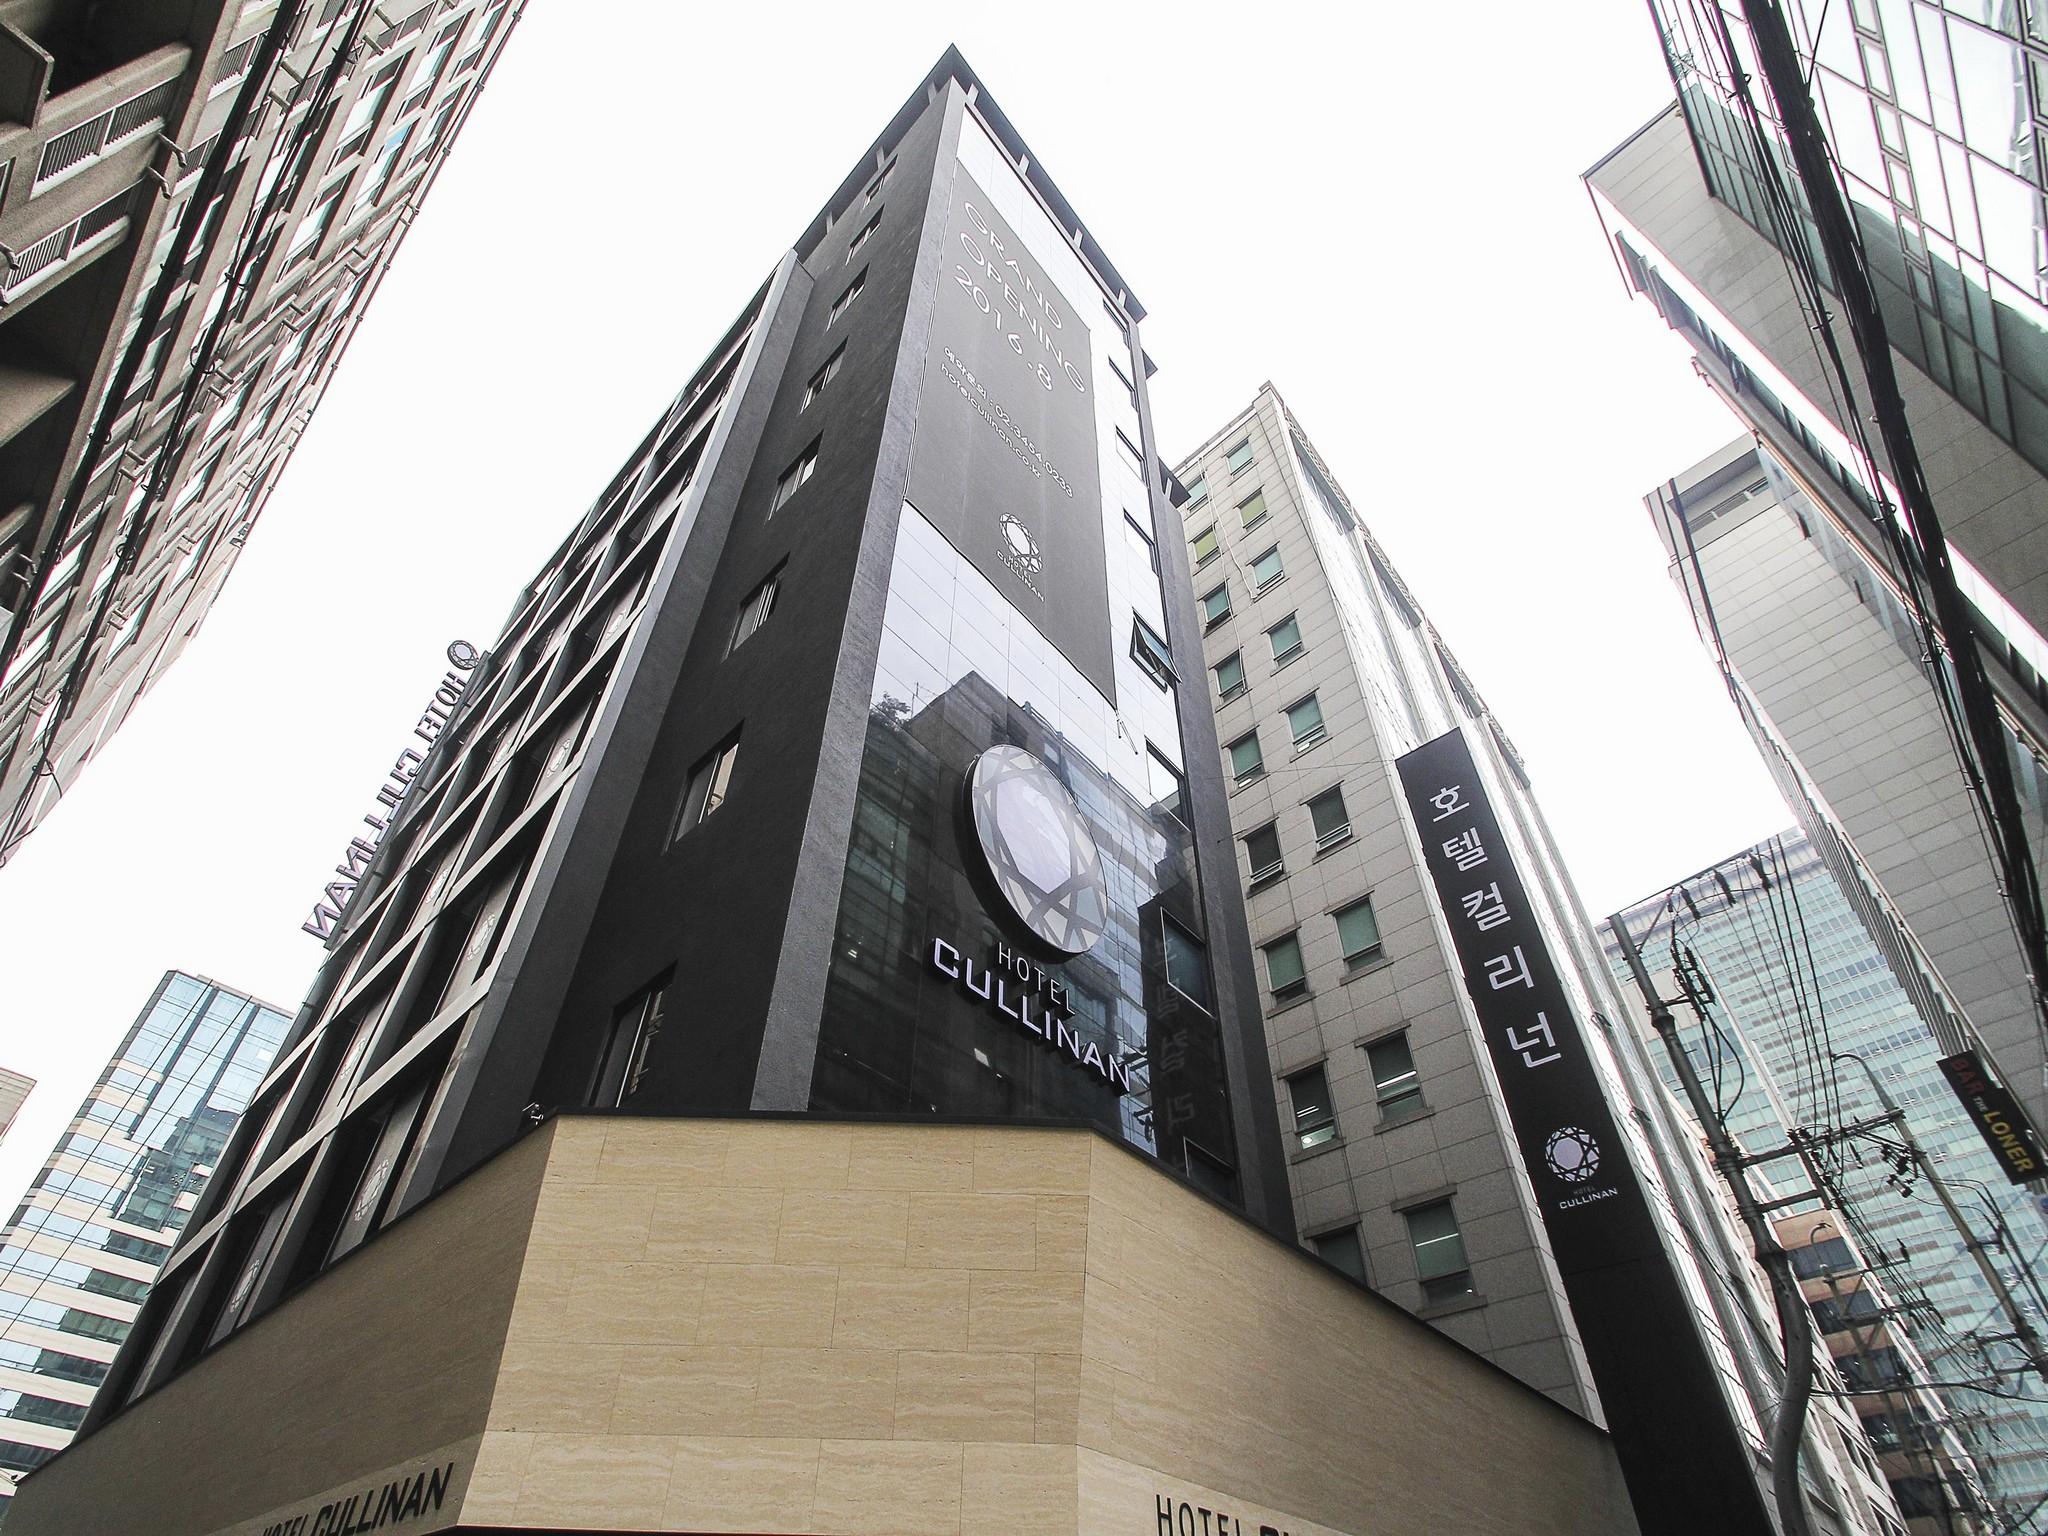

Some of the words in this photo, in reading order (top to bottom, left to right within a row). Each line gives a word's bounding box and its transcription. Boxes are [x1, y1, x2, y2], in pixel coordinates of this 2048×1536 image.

[960, 232, 1086, 393] OPENING
[964, 202, 1062, 329] GRAND
[941, 362, 1041, 479] hotelcullinan.co.kr
[996, 550, 1045, 602] CULLINAN
[933, 937, 1131, 1093] CULLINAN
[998, 941, 1076, 1016] HOTEL
[1951, 1057, 1986, 1095] BAR
[1984, 1110, 2035, 1173] LONER
[1559, 1187, 1619, 1209] CULLINAN
[310, 1462, 455, 1536] CULLINAN
